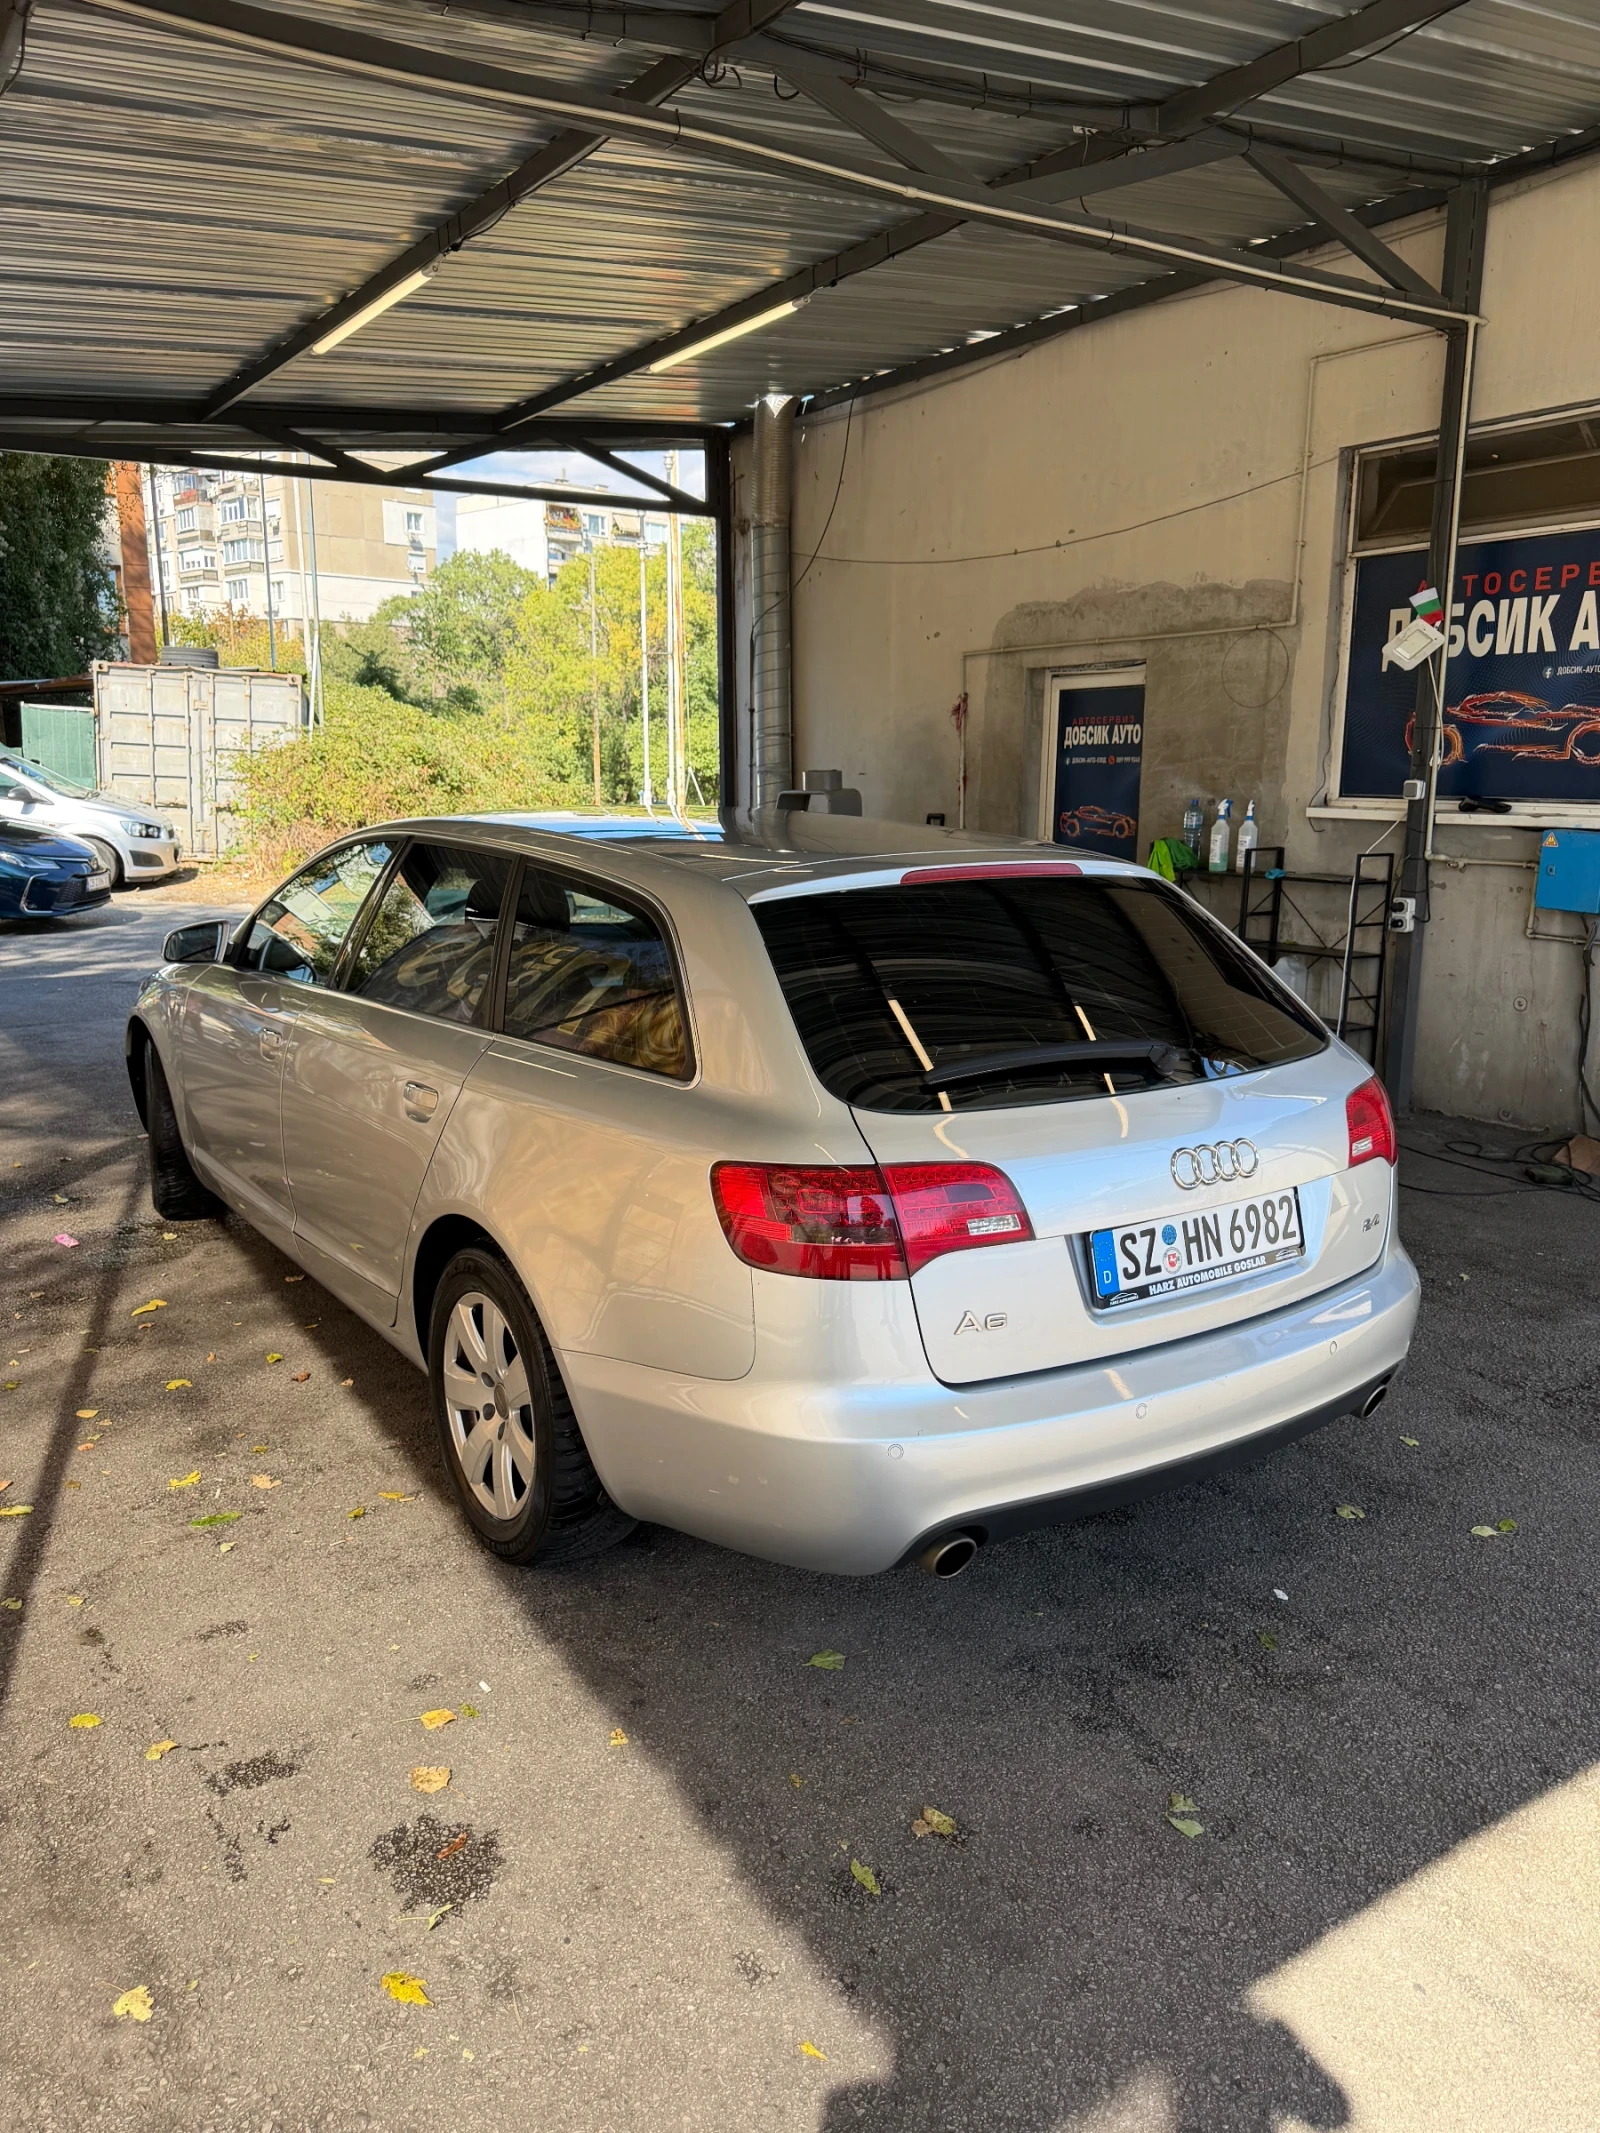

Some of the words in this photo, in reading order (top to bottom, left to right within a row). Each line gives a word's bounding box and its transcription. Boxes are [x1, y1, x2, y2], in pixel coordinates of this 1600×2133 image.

[1417, 561, 1600, 596] ТОСЕР
[1381, 594, 1561, 673] БСИК
[1063, 724, 1110, 749] ДОБСИК
[1111, 723, 1142, 745] АУТО
[1072, 714, 1135, 726] АВТОСЕРВИЗ
[1103, 1270, 1112, 1284] D
[1119, 1227, 1162, 1281] SZ
[1182, 1213, 1224, 1266] HN
[1229, 1195, 1297, 1254] 6982
[1148, 1281, 1176, 1296] HARZ
[1176, 1264, 1233, 1289] AUTOMOBILE
[1234, 1255, 1267, 1273] GOSLAR
[953, 1310, 1008, 1335] A6
